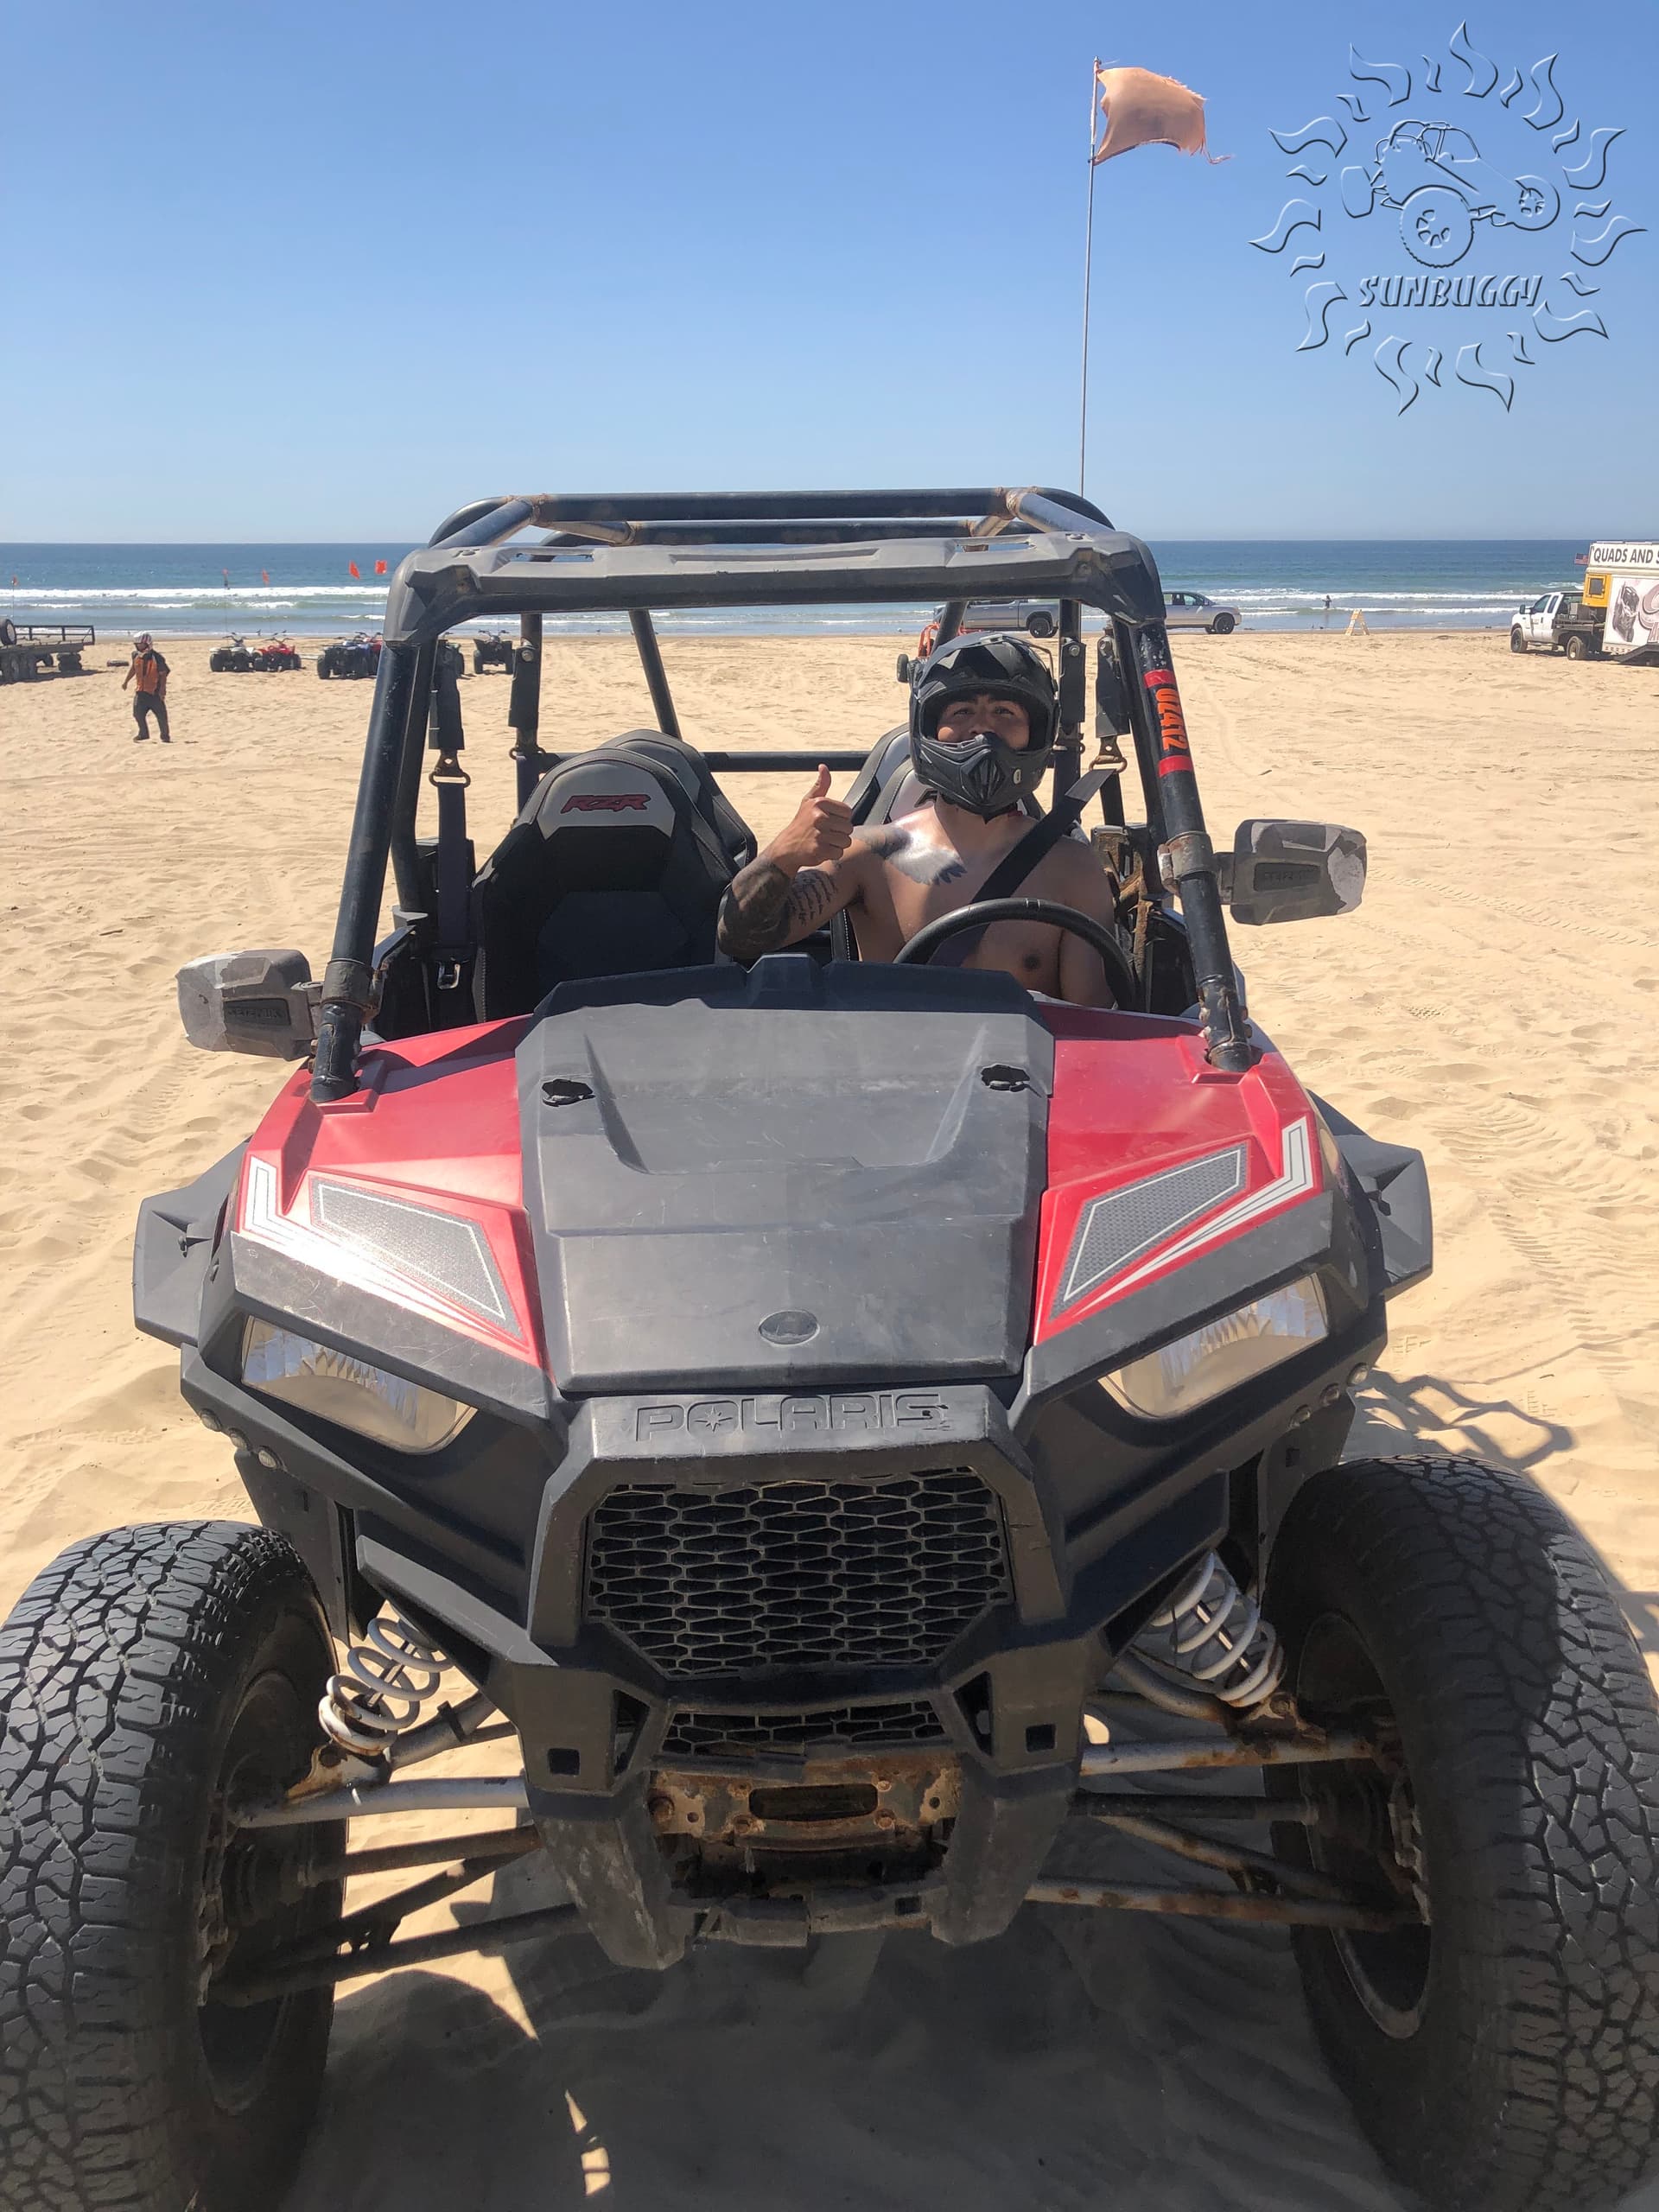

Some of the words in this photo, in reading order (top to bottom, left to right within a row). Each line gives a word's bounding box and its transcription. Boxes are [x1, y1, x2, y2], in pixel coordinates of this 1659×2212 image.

[1593, 547, 1628, 563] QUADS
[1630, 549, 1654, 564] AND
[560, 794, 652, 814] RZR
[635, 1393, 948, 1442] POLARIS
